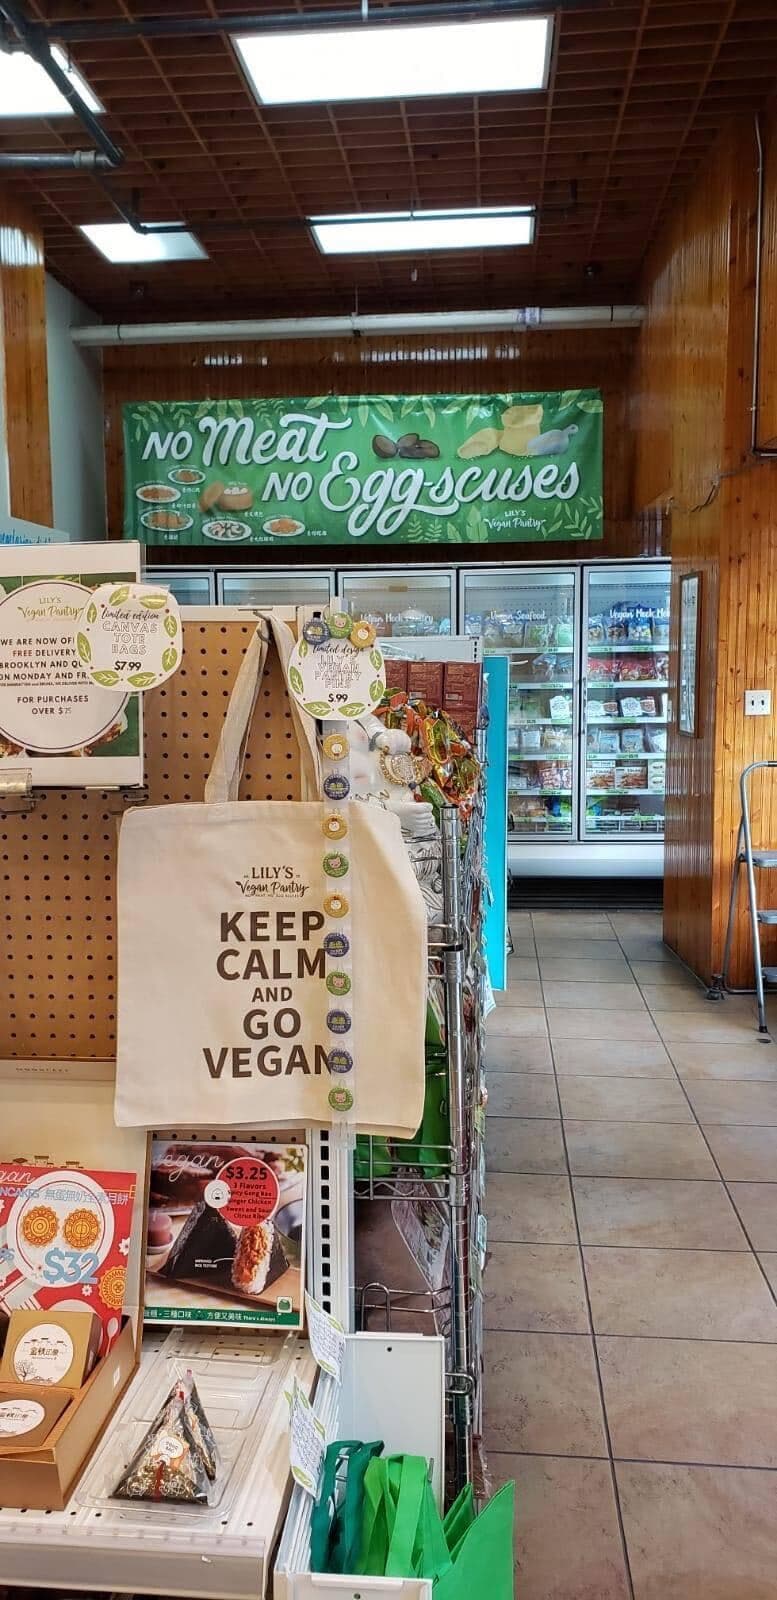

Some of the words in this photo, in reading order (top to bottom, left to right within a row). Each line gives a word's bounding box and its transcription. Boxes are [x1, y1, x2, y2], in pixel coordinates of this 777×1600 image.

[141, 430, 193, 461] NO
[198, 412, 353, 467] Meat
[261, 471, 314, 502] NO
[318, 451, 580, 536] Egg-scuses
[483, 517, 511, 532] Vegan
[512, 517, 547, 532] Pantry
[39, 596, 62, 605] LILY'S
[17, 606, 46, 621] Vegan
[48, 605, 84, 621] Pantry
[101, 607, 129, 620] limited
[132, 608, 160, 620] edition
[515, 609, 546, 622] Seafood
[609, 608, 634, 622] Vegan
[102, 620, 158, 633] CANVAS
[1, 638, 13, 646] WE
[16, 638, 33, 646] ARE
[35, 637, 58, 645] NOW
[114, 633, 145, 645] TOTE
[12, 649, 33, 657] FREE
[35, 648, 76, 657] DELIVERY
[111, 643, 147, 655] BAGS
[0, 660, 47, 669] BROOKLYN
[49, 660, 69, 669] AND
[114, 660, 142, 672] $7.99
[13, 672, 52, 681] MONDAY
[55, 671, 74, 680] AND
[17, 696, 34, 704] FOR
[37, 695, 89, 703] PURCHASES
[31, 707, 55, 715] OVER
[251, 865, 294, 879] LILY'S
[235, 879, 268, 896] Vegan
[270, 880, 310, 898] Pantry
[220, 910, 325, 943] KEEP
[216, 947, 327, 982] CALM
[251, 986, 293, 1003] AND
[242, 1007, 302, 1041] GO
[202, 1043, 332, 1080] VEGAN
[225, 1166, 268, 1180] $3.25
[239, 1182, 267, 1190] Flavors
[43, 1247, 99, 1284] $32
